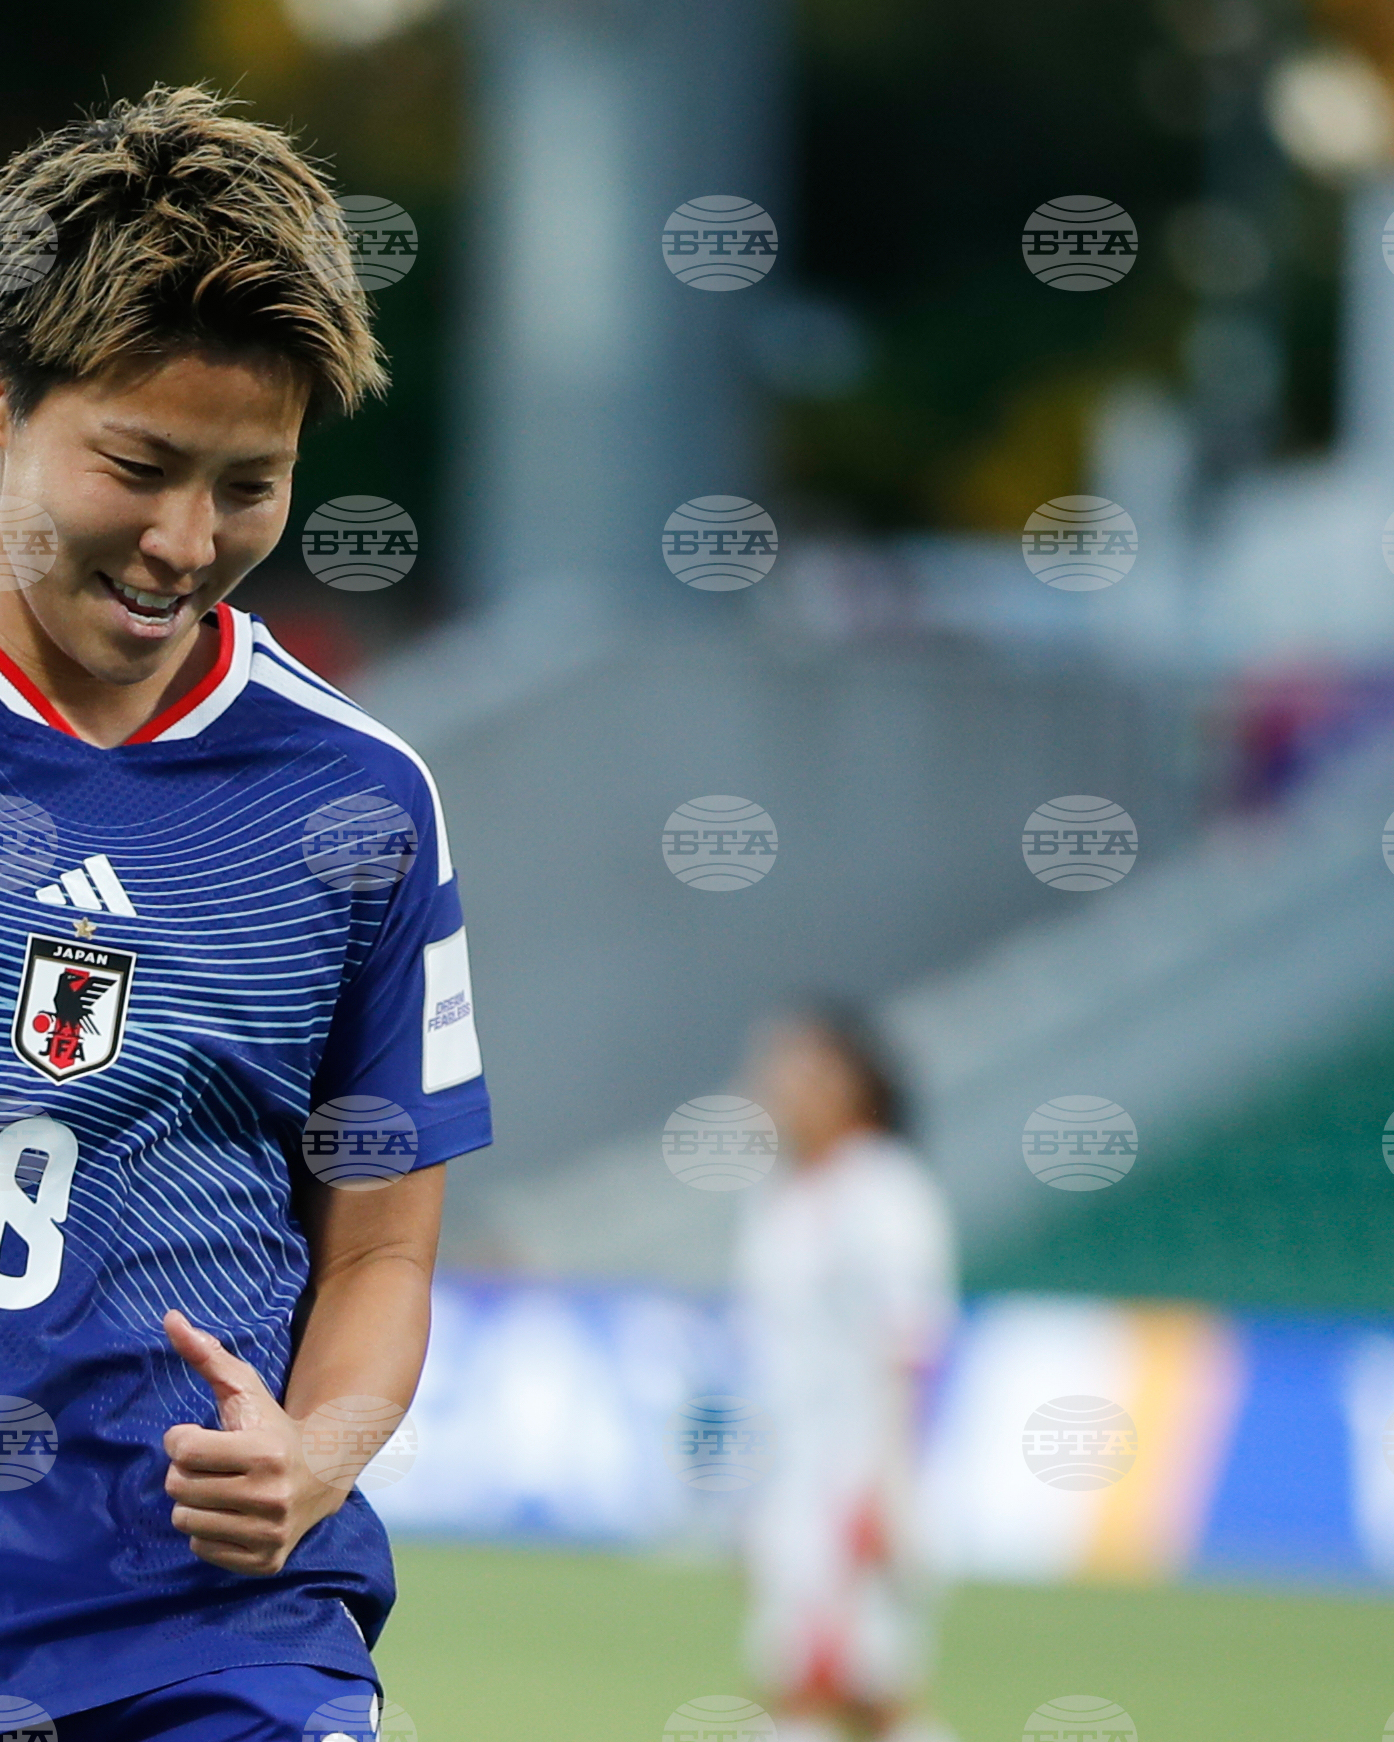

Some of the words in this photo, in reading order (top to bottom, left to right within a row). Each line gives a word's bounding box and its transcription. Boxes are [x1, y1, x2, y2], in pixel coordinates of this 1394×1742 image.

[53, 946, 108, 966] JAPAN
[427, 1002, 470, 1032] FEARLESS
[38, 1037, 86, 1062] JFA
